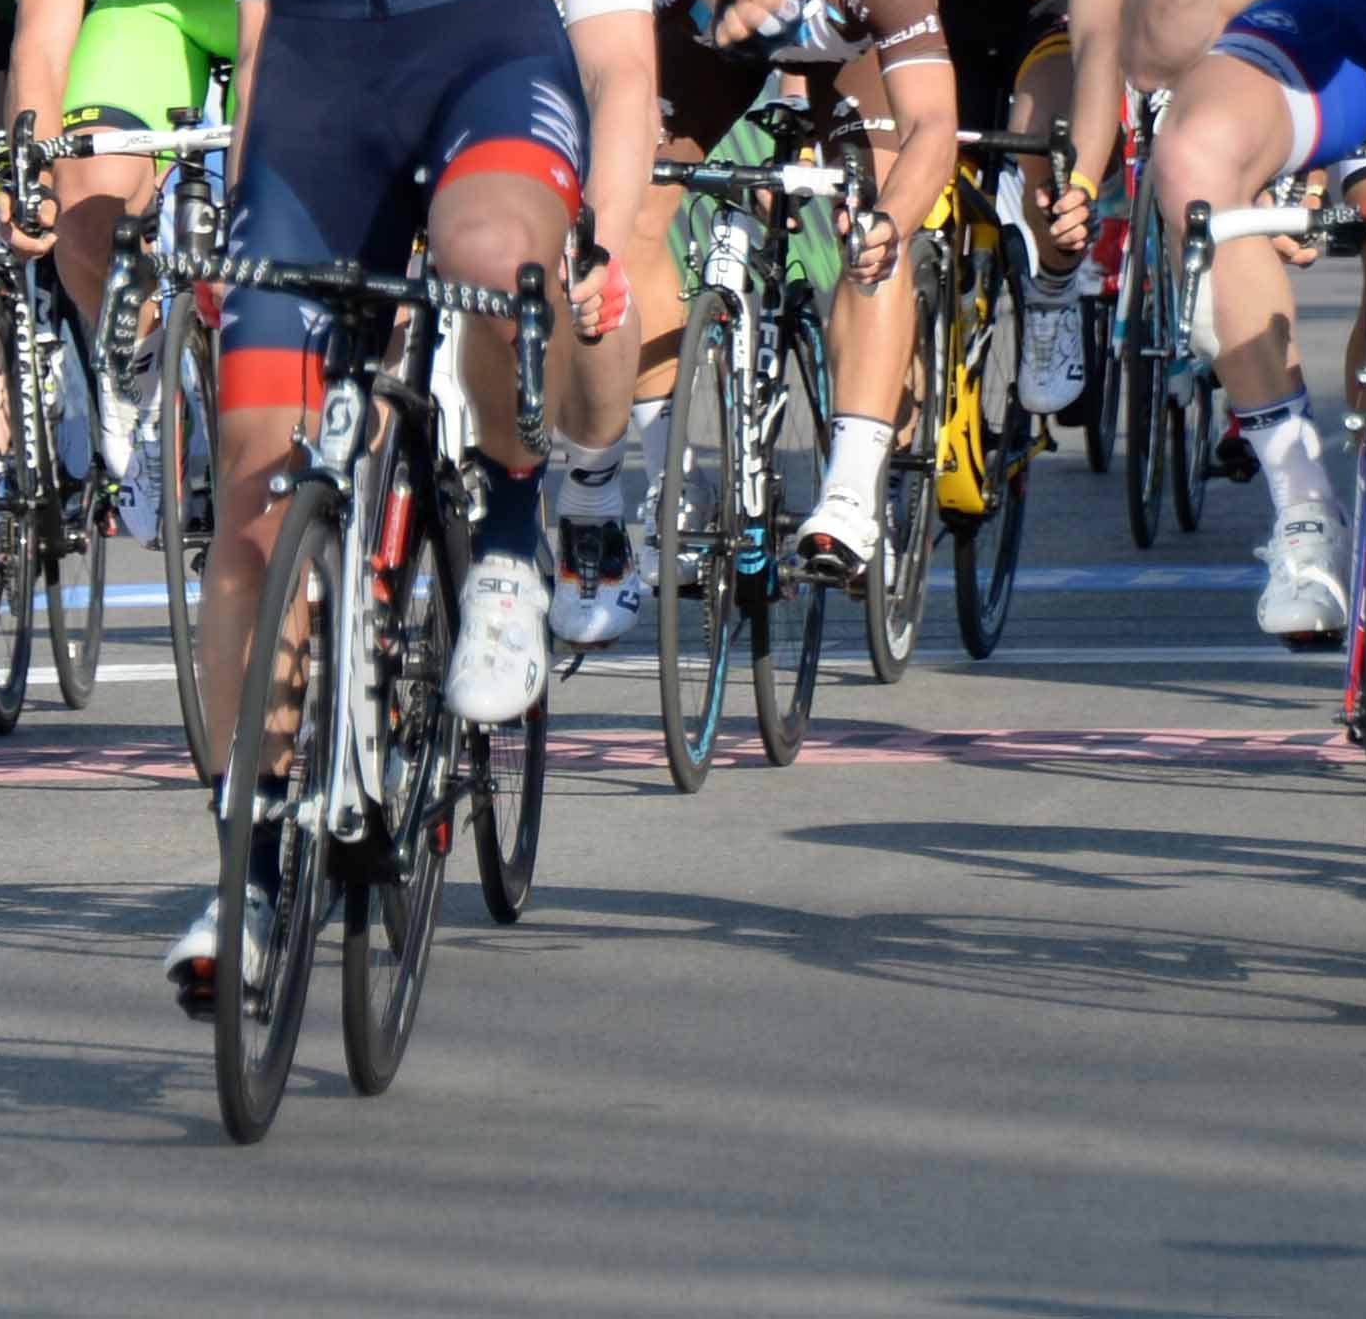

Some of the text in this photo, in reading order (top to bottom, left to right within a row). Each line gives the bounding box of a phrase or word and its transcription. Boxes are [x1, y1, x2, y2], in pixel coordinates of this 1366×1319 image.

[1322, 206, 1362, 225] PR
[14, 302, 38, 469] COLNAGO
[476, 577, 520, 598] SIDI
